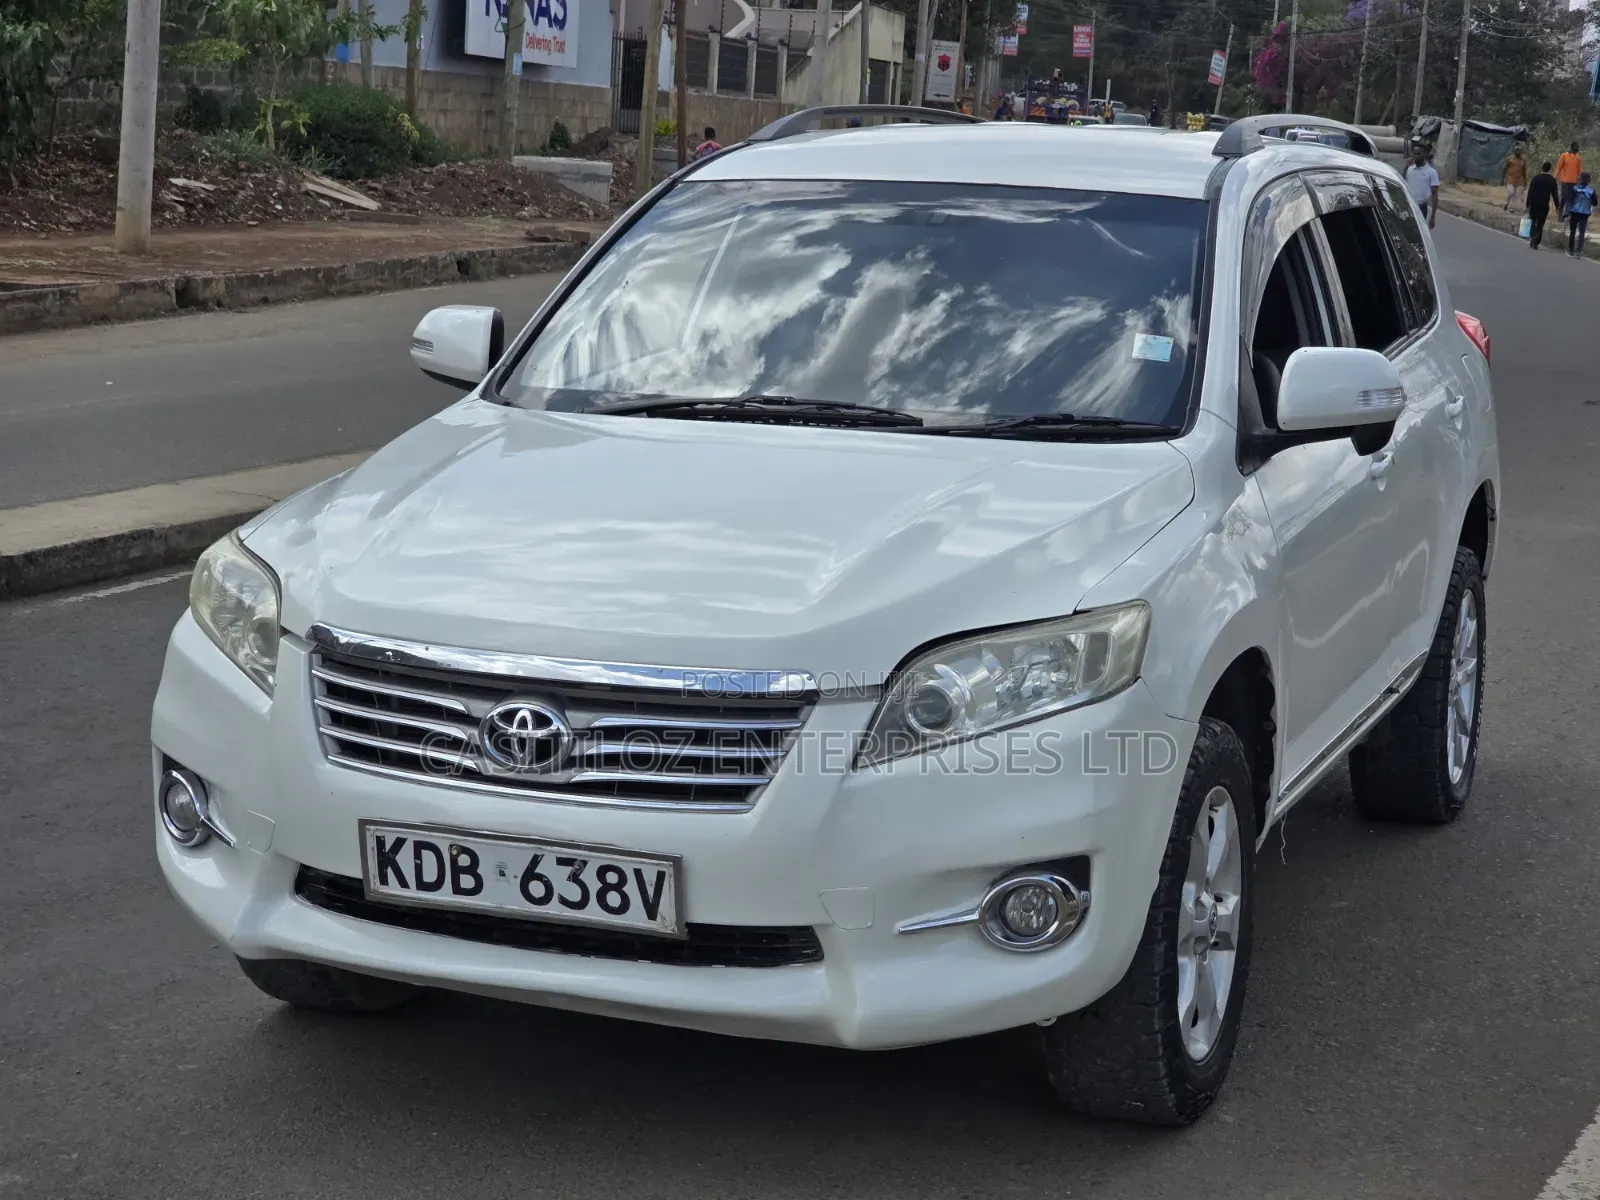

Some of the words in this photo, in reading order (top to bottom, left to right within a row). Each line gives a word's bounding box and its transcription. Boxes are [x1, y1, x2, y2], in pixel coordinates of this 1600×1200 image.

[525, 31, 551, 56] Delivering
[552, 36, 566, 54] Trust
[375, 835, 484, 897] KDB
[518, 853, 667, 922] 638V
